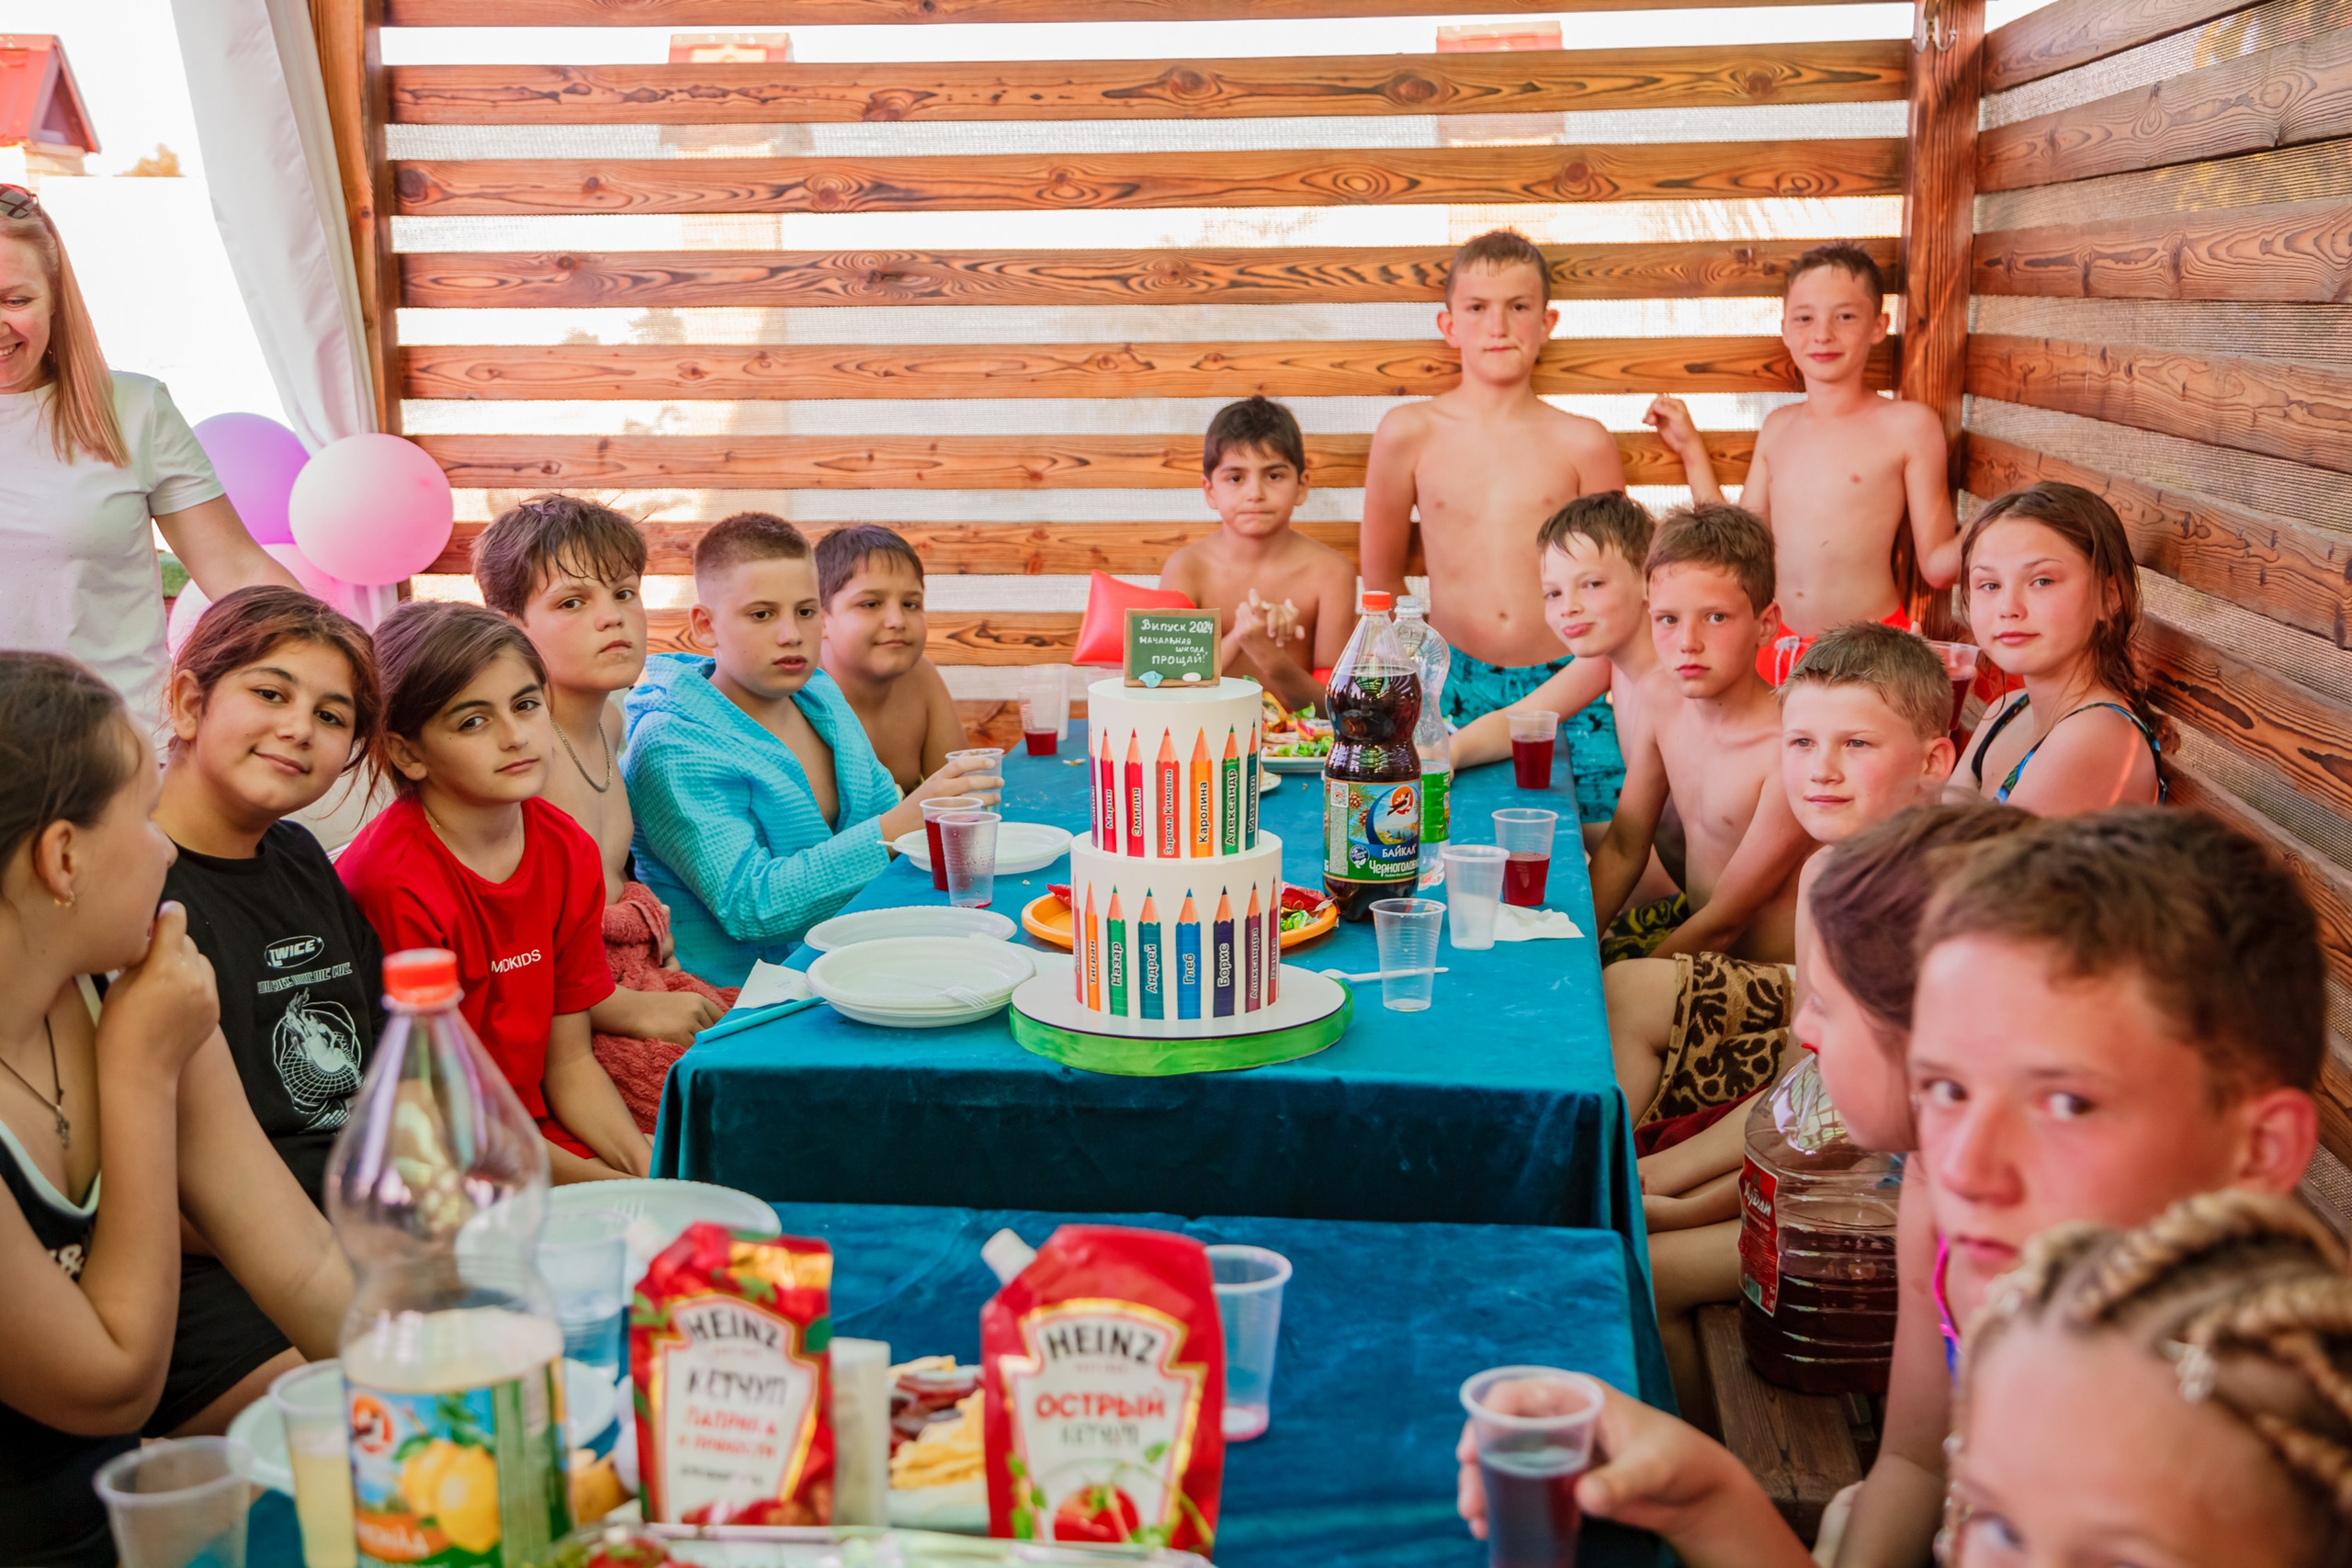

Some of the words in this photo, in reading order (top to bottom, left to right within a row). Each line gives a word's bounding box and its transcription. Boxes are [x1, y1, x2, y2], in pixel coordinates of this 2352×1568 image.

[1140, 618, 1186, 632] Выпуск
[1189, 620, 1214, 634] 2024
[1165, 769, 1173, 815] Кимовна
[1226, 769, 1238, 845] Александр
[1132, 788, 1142, 837] Эмилия
[1199, 782, 1210, 843] Каролина
[1164, 817, 1173, 855] Зарема
[1382, 845, 1416, 858] БАЙКАЛ
[1369, 859, 1419, 877] Черноголов
[268, 939, 316, 967] TWICE
[1112, 942, 1124, 986] Назар
[1146, 944, 1158, 994] Андрей
[1184, 953, 1194, 985] Глеб
[1217, 942, 1229, 987] Борис
[687, 1310, 779, 1348] HEINZ
[1046, 1325, 1158, 1362] HEINZ
[687, 1368, 787, 1406] КЕТЧУП
[1035, 1388, 1166, 1420] ОСТРЫЙ
